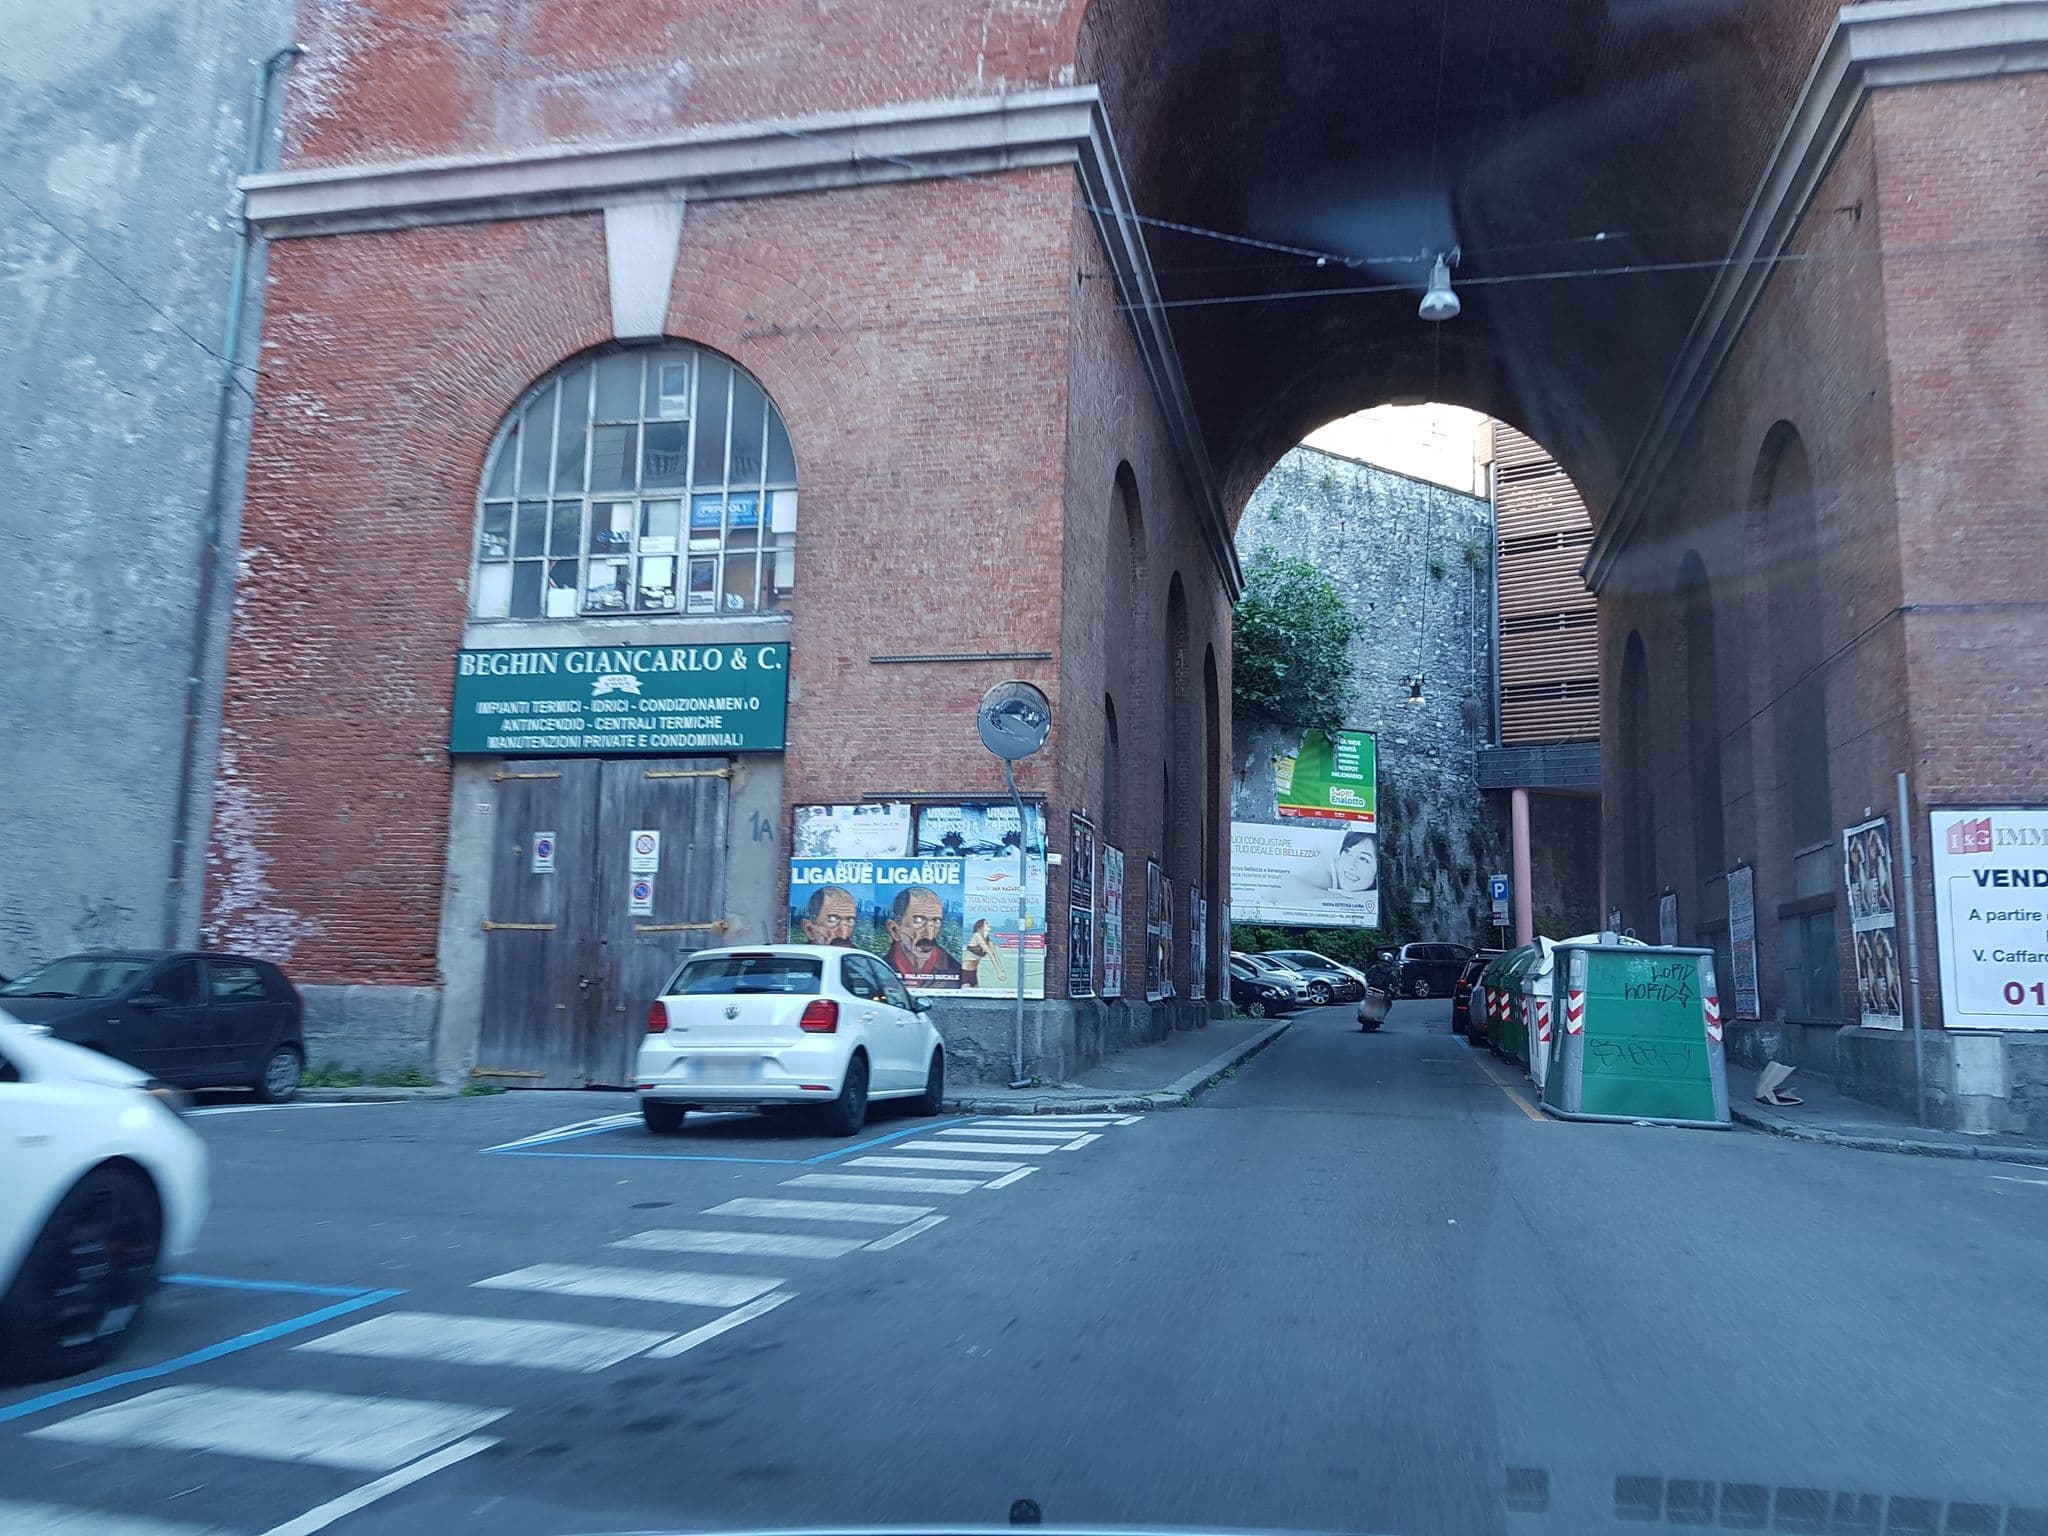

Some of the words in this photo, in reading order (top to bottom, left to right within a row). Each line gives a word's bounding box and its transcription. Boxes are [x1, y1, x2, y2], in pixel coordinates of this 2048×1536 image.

[459, 652, 559, 676] BEGHIN
[565, 648, 723, 675] GIANCARLO
[731, 647, 748, 670] &
[757, 647, 782, 670] C.
[476, 701, 530, 714] IMPIANTI
[532, 700, 581, 714] TERMICI
[591, 699, 629, 713] IDRICI
[501, 718, 584, 732] ANTINCENDIO
[595, 717, 656, 731] CENTRALI
[659, 716, 723, 730] TERMICHE
[487, 735, 581, 749] MANUTENZIONI
[583, 734, 635, 748] PRIVATE
[639, 734, 647, 748] E
[650, 733, 743, 748] CONDOMINIALI
[1331, 796, 1364, 806] Enalotto
[748, 810, 775, 842] 1A
[1244, 836, 1292, 848] CONQUISTARE
[1250, 846, 1274, 855] IDEALE
[793, 867, 873, 884] LIGABUE
[876, 867, 960, 884] LIGABUE
[1973, 868, 2048, 888] VEND
[1494, 883, 1505, 898] P
[1969, 909, 1982, 921] A
[1986, 908, 2042, 924] partire
[1973, 949, 1987, 962] V.
